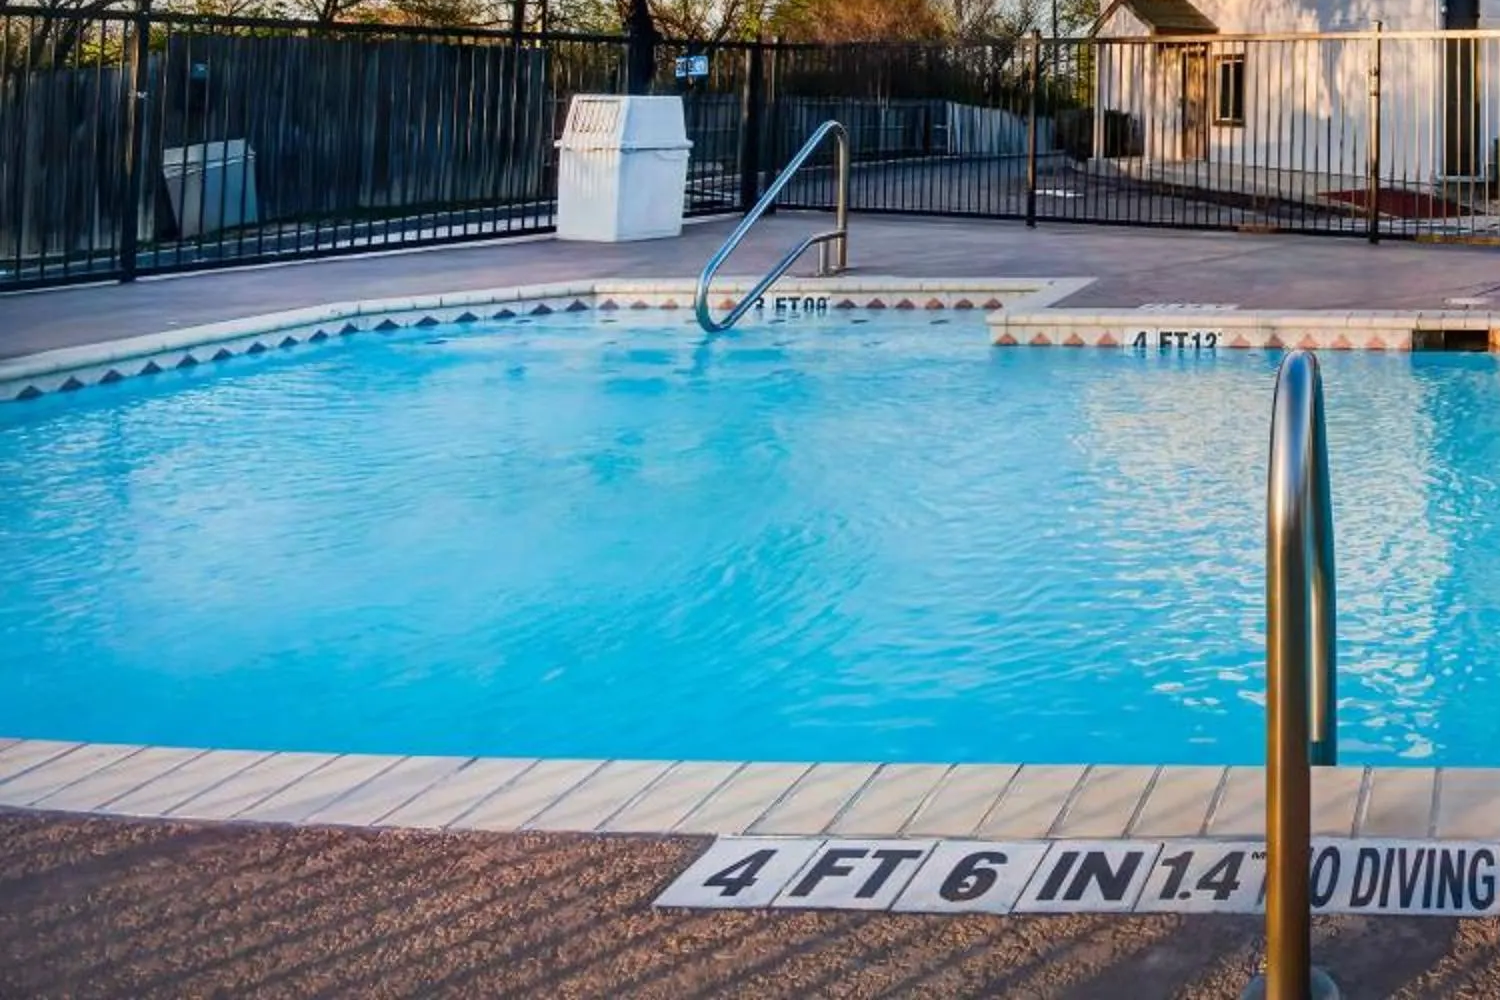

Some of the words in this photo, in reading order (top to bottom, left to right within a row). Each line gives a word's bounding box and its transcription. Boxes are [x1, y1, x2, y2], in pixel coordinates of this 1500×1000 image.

[1159, 331, 1188, 349] FT
[703, 849, 778, 897] 4
[789, 849, 923, 899] FT
[939, 851, 1009, 902] 6
[1035, 851, 1145, 901] IN
[1350, 846, 1496, 911] DIVING
